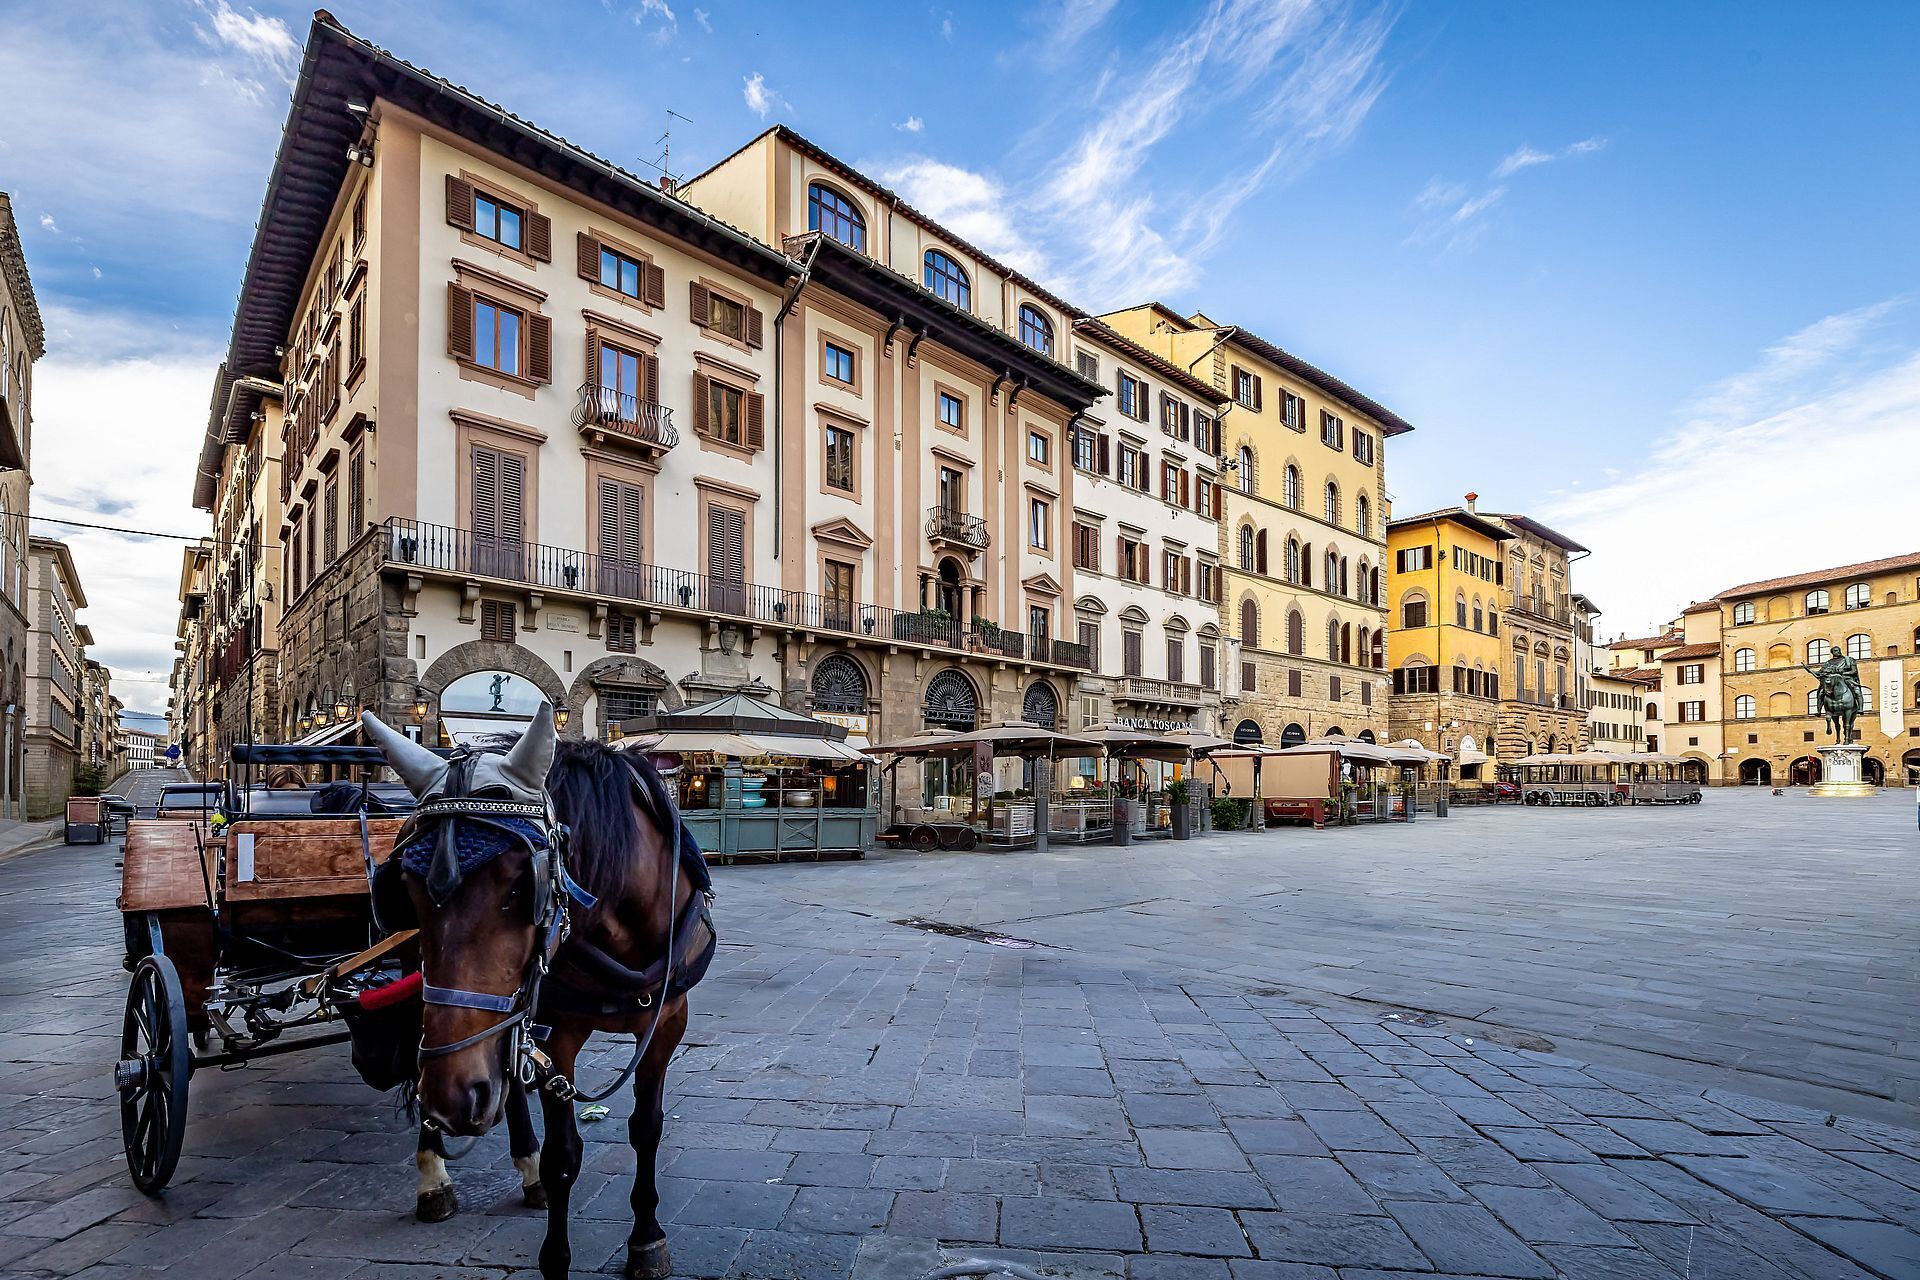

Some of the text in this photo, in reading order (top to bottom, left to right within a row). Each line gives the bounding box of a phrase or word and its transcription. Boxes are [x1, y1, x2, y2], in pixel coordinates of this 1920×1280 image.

[1891, 680, 1899, 713] GUCCI
[1117, 717, 1193, 731] BANCA TOSCANA
[405, 725, 421, 744] T
